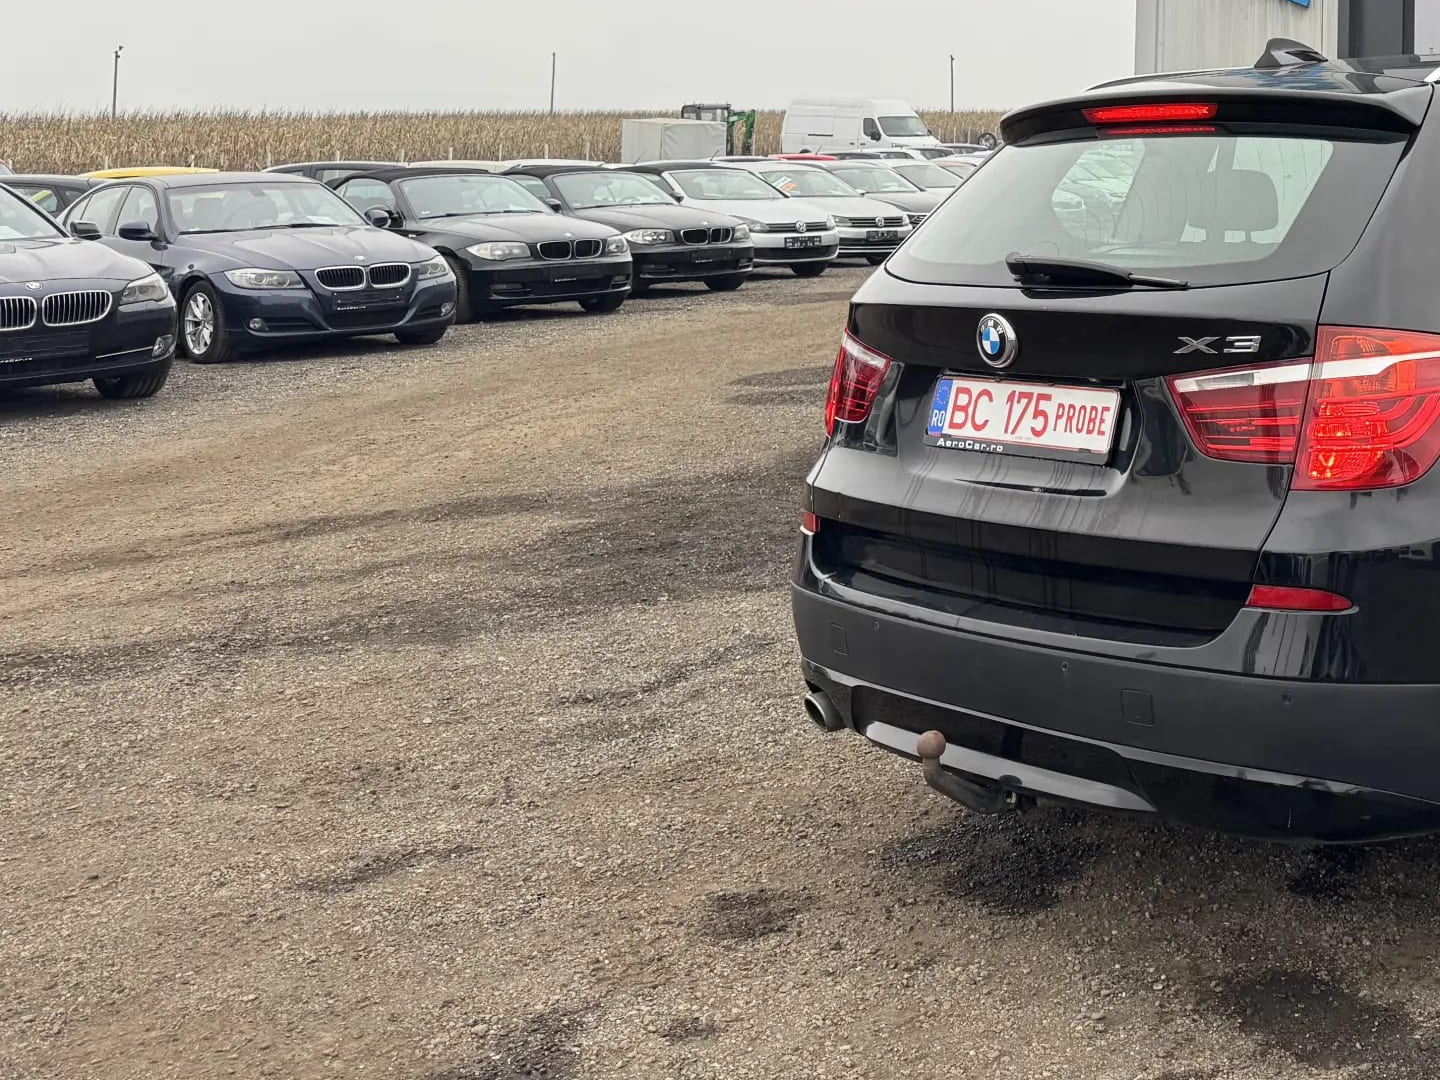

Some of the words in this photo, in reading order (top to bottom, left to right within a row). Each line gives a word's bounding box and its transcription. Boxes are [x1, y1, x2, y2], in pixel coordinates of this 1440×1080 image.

[1172, 335, 1262, 354] X3
[931, 409, 946, 428] RO
[948, 386, 993, 432] BC
[1003, 390, 1053, 438] 175
[1053, 402, 1111, 437] PROBE
[936, 438, 1004, 452] AeroCar.ro
